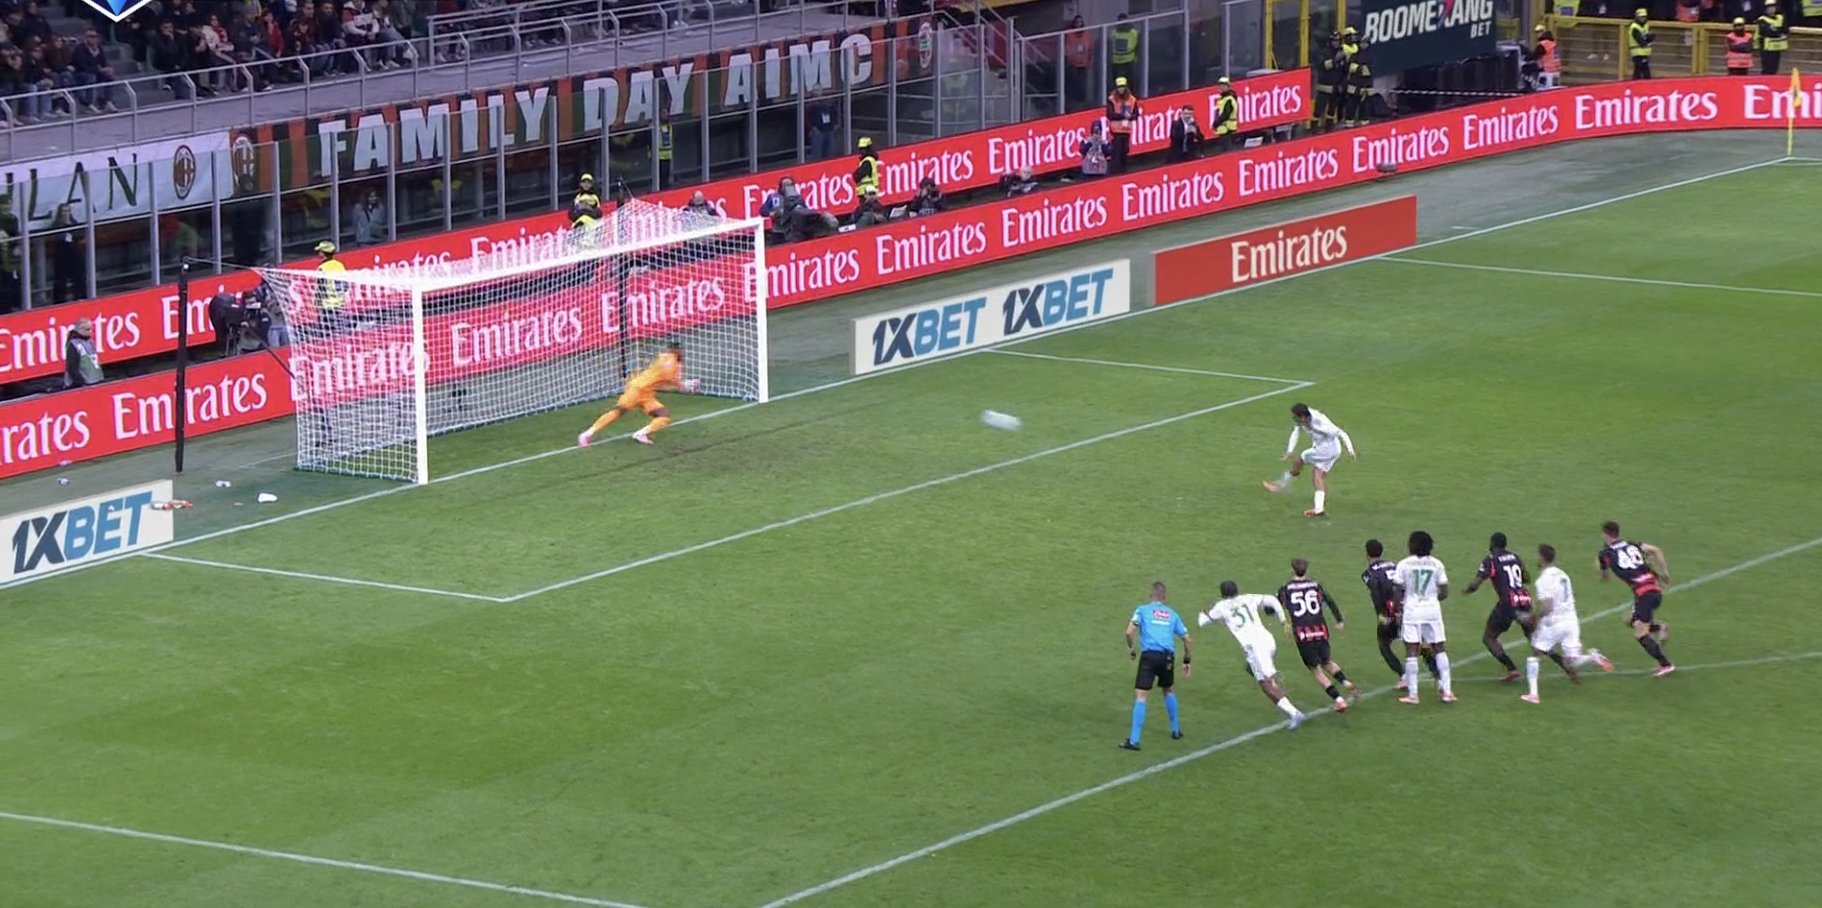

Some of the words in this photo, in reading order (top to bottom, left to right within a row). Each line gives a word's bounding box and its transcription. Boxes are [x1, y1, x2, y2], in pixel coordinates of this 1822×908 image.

[1470, 21, 1492, 39] BET
[318, 87, 549, 178] FAMILY
[583, 61, 694, 131] DAY
[724, 33, 872, 107] AIMC
[112, 373, 267, 440] Emrates
[450, 305, 583, 367] Emirates
[601, 275, 725, 334] Emirates
[876, 222, 986, 275] Emirates
[1002, 196, 1107, 247] Emirates
[1122, 172, 1224, 221] Emirates
[1238, 148, 1338, 196] Emirates
[1352, 126, 1449, 173] Emirates
[1462, 105, 1558, 150] Emirates
[1575, 88, 1718, 129] Emirates
[1231, 225, 1347, 283] Emirates
[0, 311, 140, 373] Emirtes
[872, 297, 987, 366] 1XBET
[1002, 268, 1113, 335] 1XBET
[12, 491, 153, 574] 1XBET
[1290, 589, 1320, 617] 56
[1412, 568, 1434, 596] 17
[1503, 563, 1522, 588] 19
[1230, 603, 1254, 628] 31
